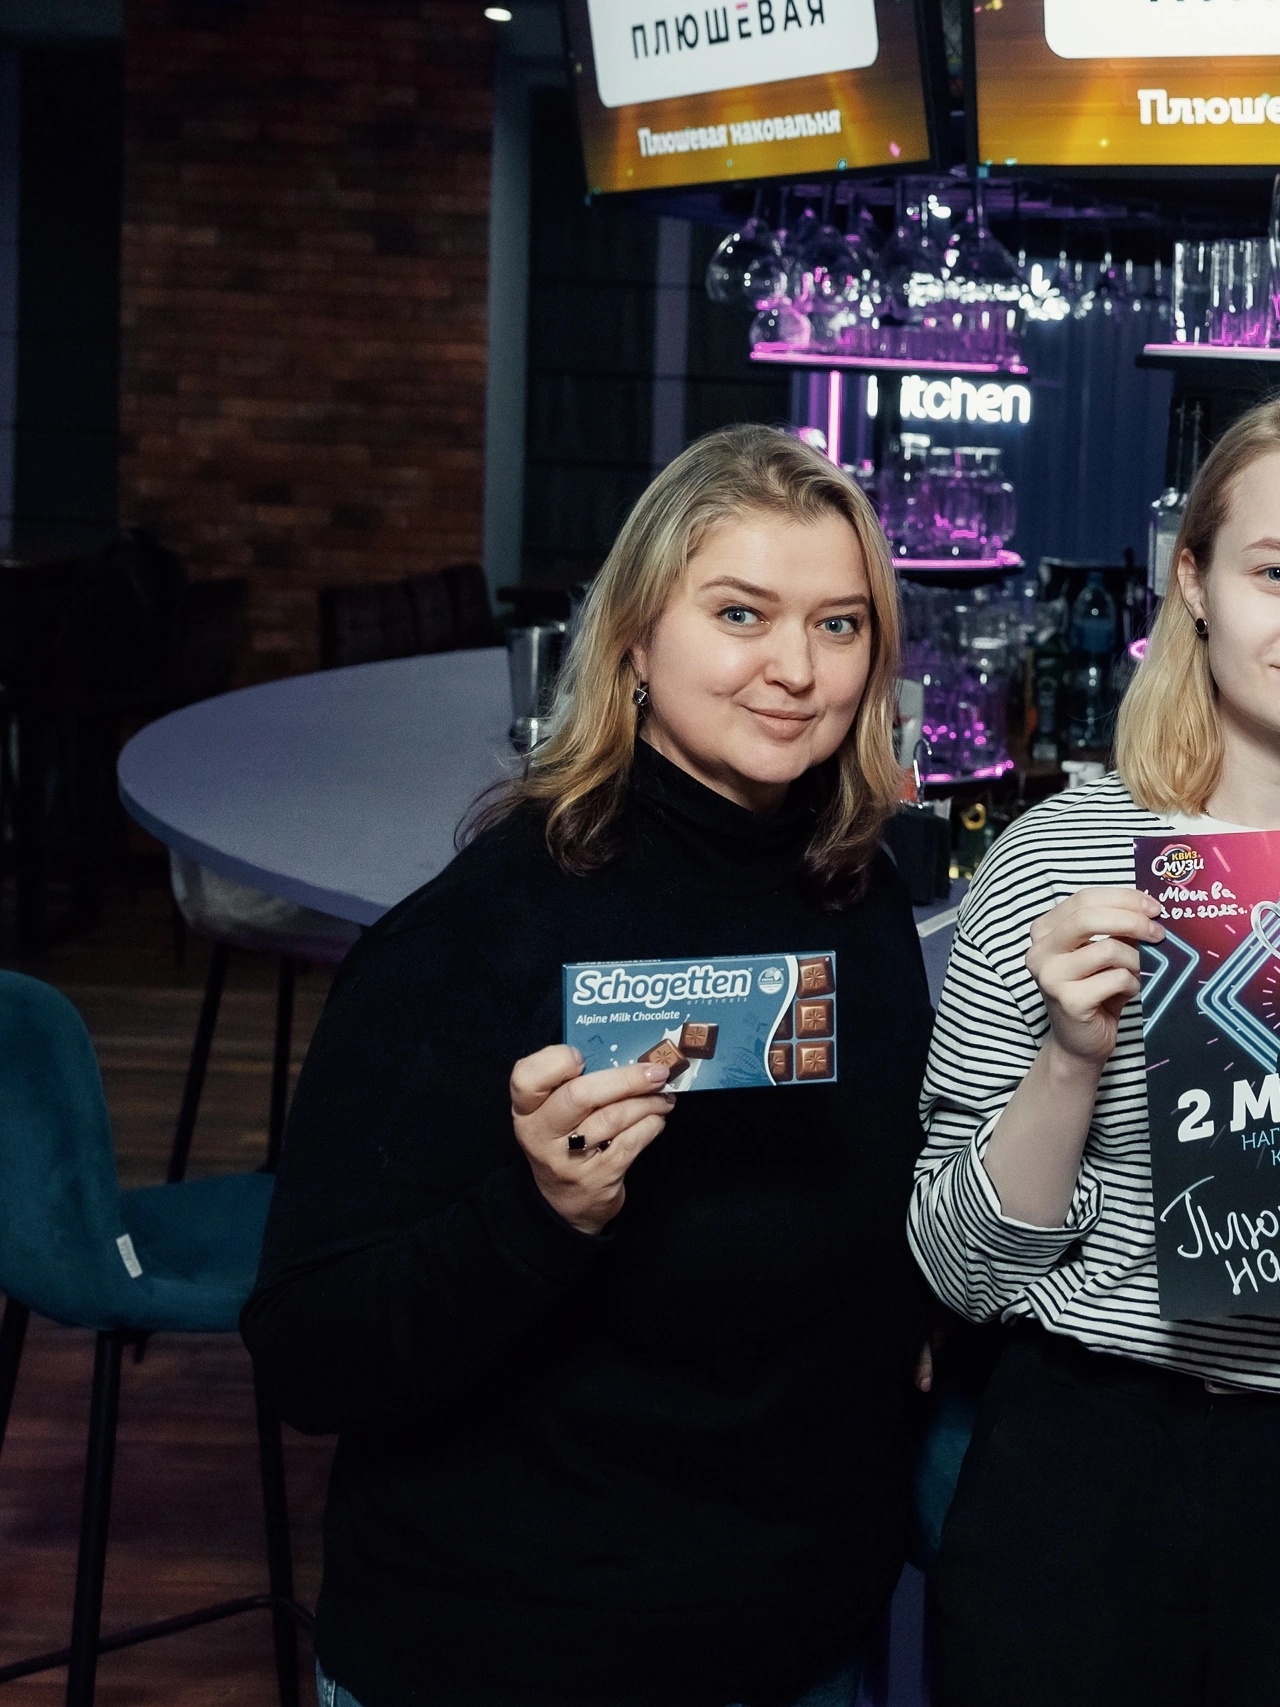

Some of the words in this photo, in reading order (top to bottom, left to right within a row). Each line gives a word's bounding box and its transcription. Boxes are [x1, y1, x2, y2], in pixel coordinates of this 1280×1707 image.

[631, 0, 825, 59] ПЛЮШЕВАЯ
[638, 124, 728, 157] Плюшевая
[729, 109, 842, 146] наковальня
[1151, 855, 1205, 877] Смузи
[1171, 850, 1198, 861] КВИЗ
[1158, 881, 1237, 903] Москва
[573, 964, 752, 1009] Schogetten
[687, 996, 748, 1006] originals
[576, 1013, 608, 1025] Alpine
[609, 1012, 631, 1023] Milk
[632, 1009, 680, 1021] Chocolate
[1177, 1088, 1215, 1143] 2
